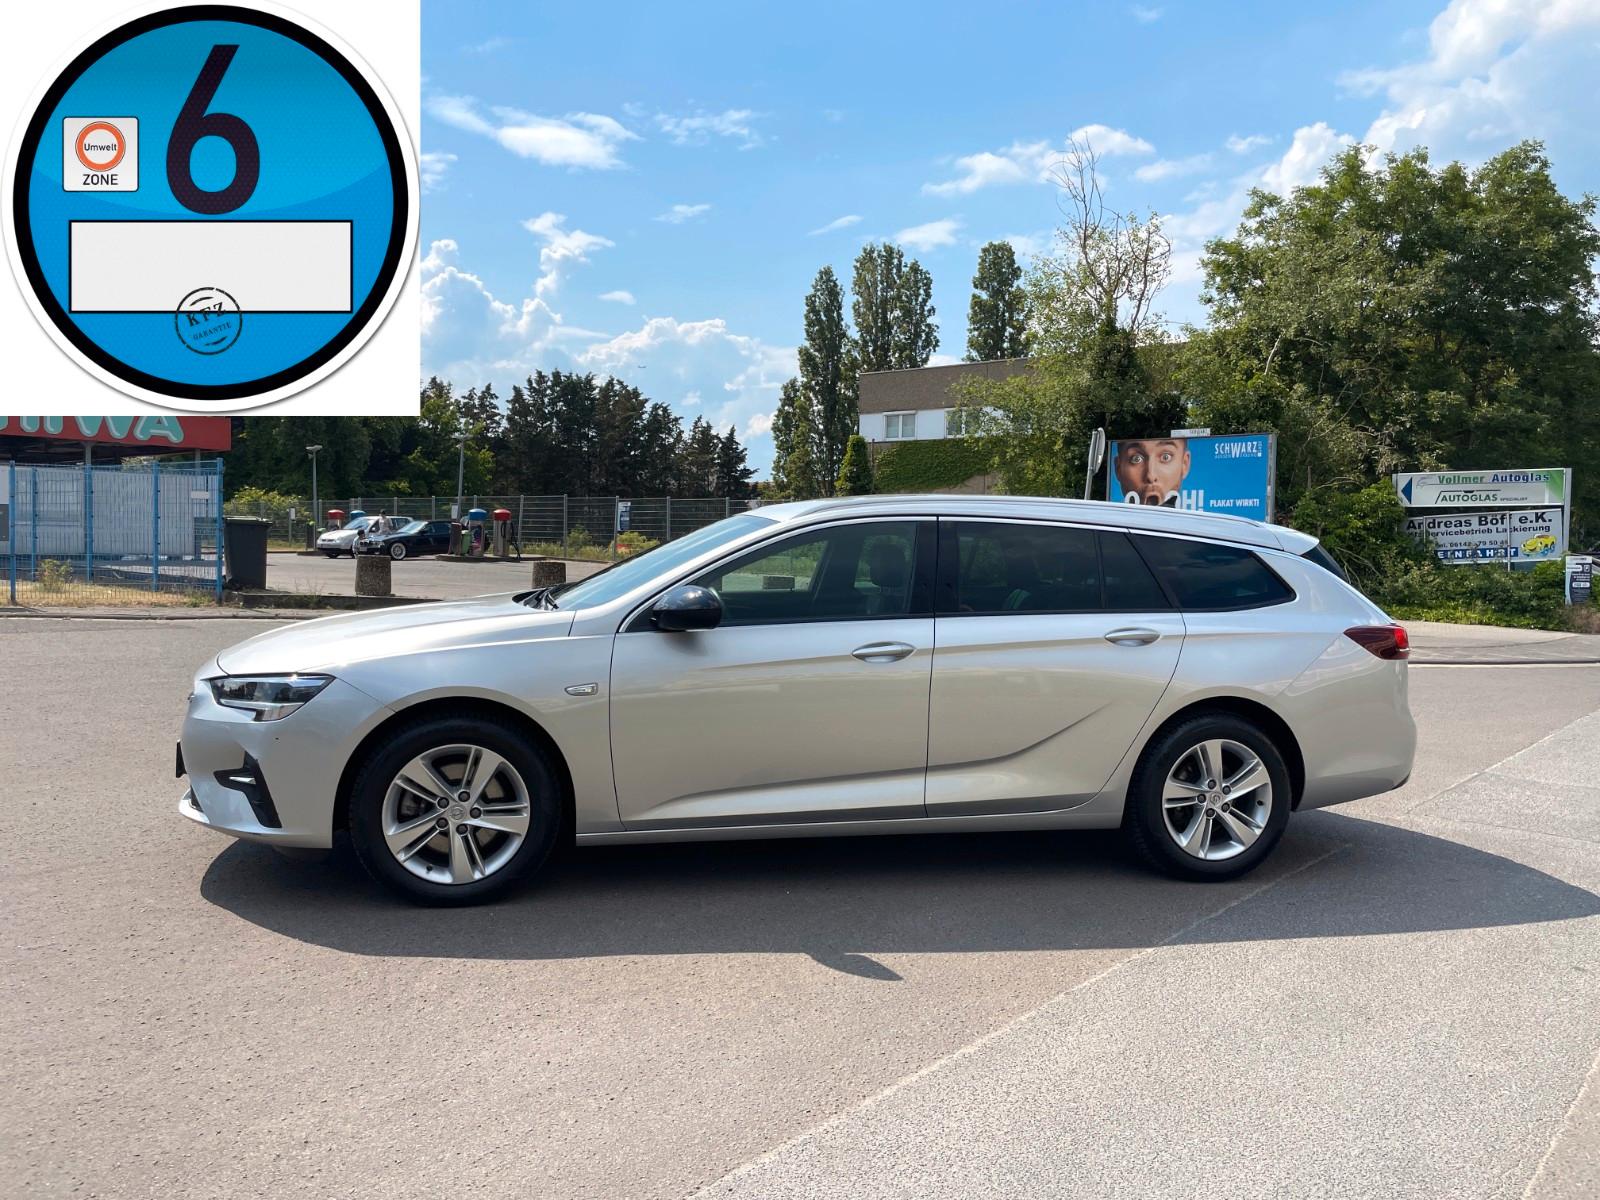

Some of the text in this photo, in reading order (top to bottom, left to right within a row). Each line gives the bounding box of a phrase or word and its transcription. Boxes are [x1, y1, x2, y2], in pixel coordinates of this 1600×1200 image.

[1214, 441, 1258, 459] SCHWARZ
[1437, 473, 1550, 484] Vollmer Autoglas
[1209, 500, 1234, 508] PLAKAT
[1440, 494, 1498, 503] AUTOGLAS
[1407, 519, 1472, 530] Andreas
[1519, 511, 1552, 524] e.K.
